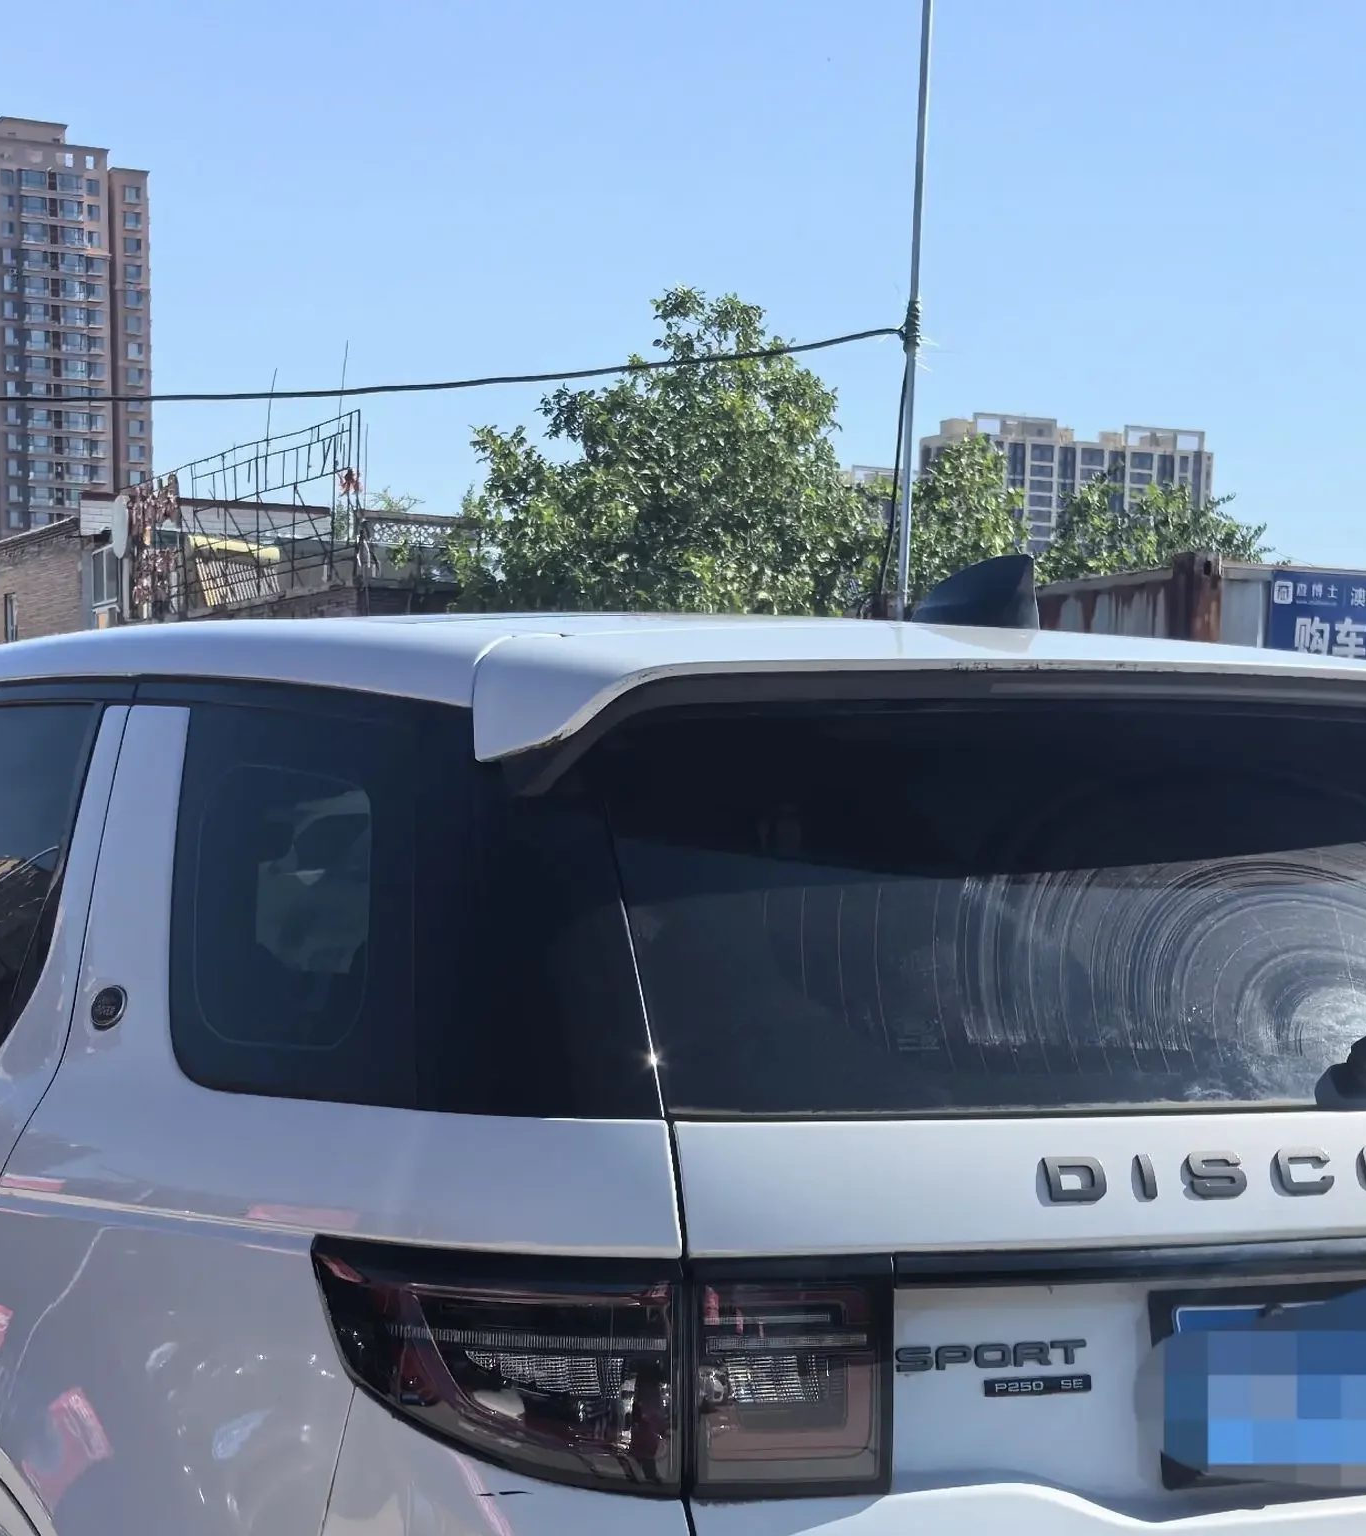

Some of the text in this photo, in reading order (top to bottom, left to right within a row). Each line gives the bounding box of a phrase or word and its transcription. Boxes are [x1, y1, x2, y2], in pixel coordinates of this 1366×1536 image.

[895, 1339, 1088, 1373] SPORT
[994, 1378, 1084, 1393] P250 SE
